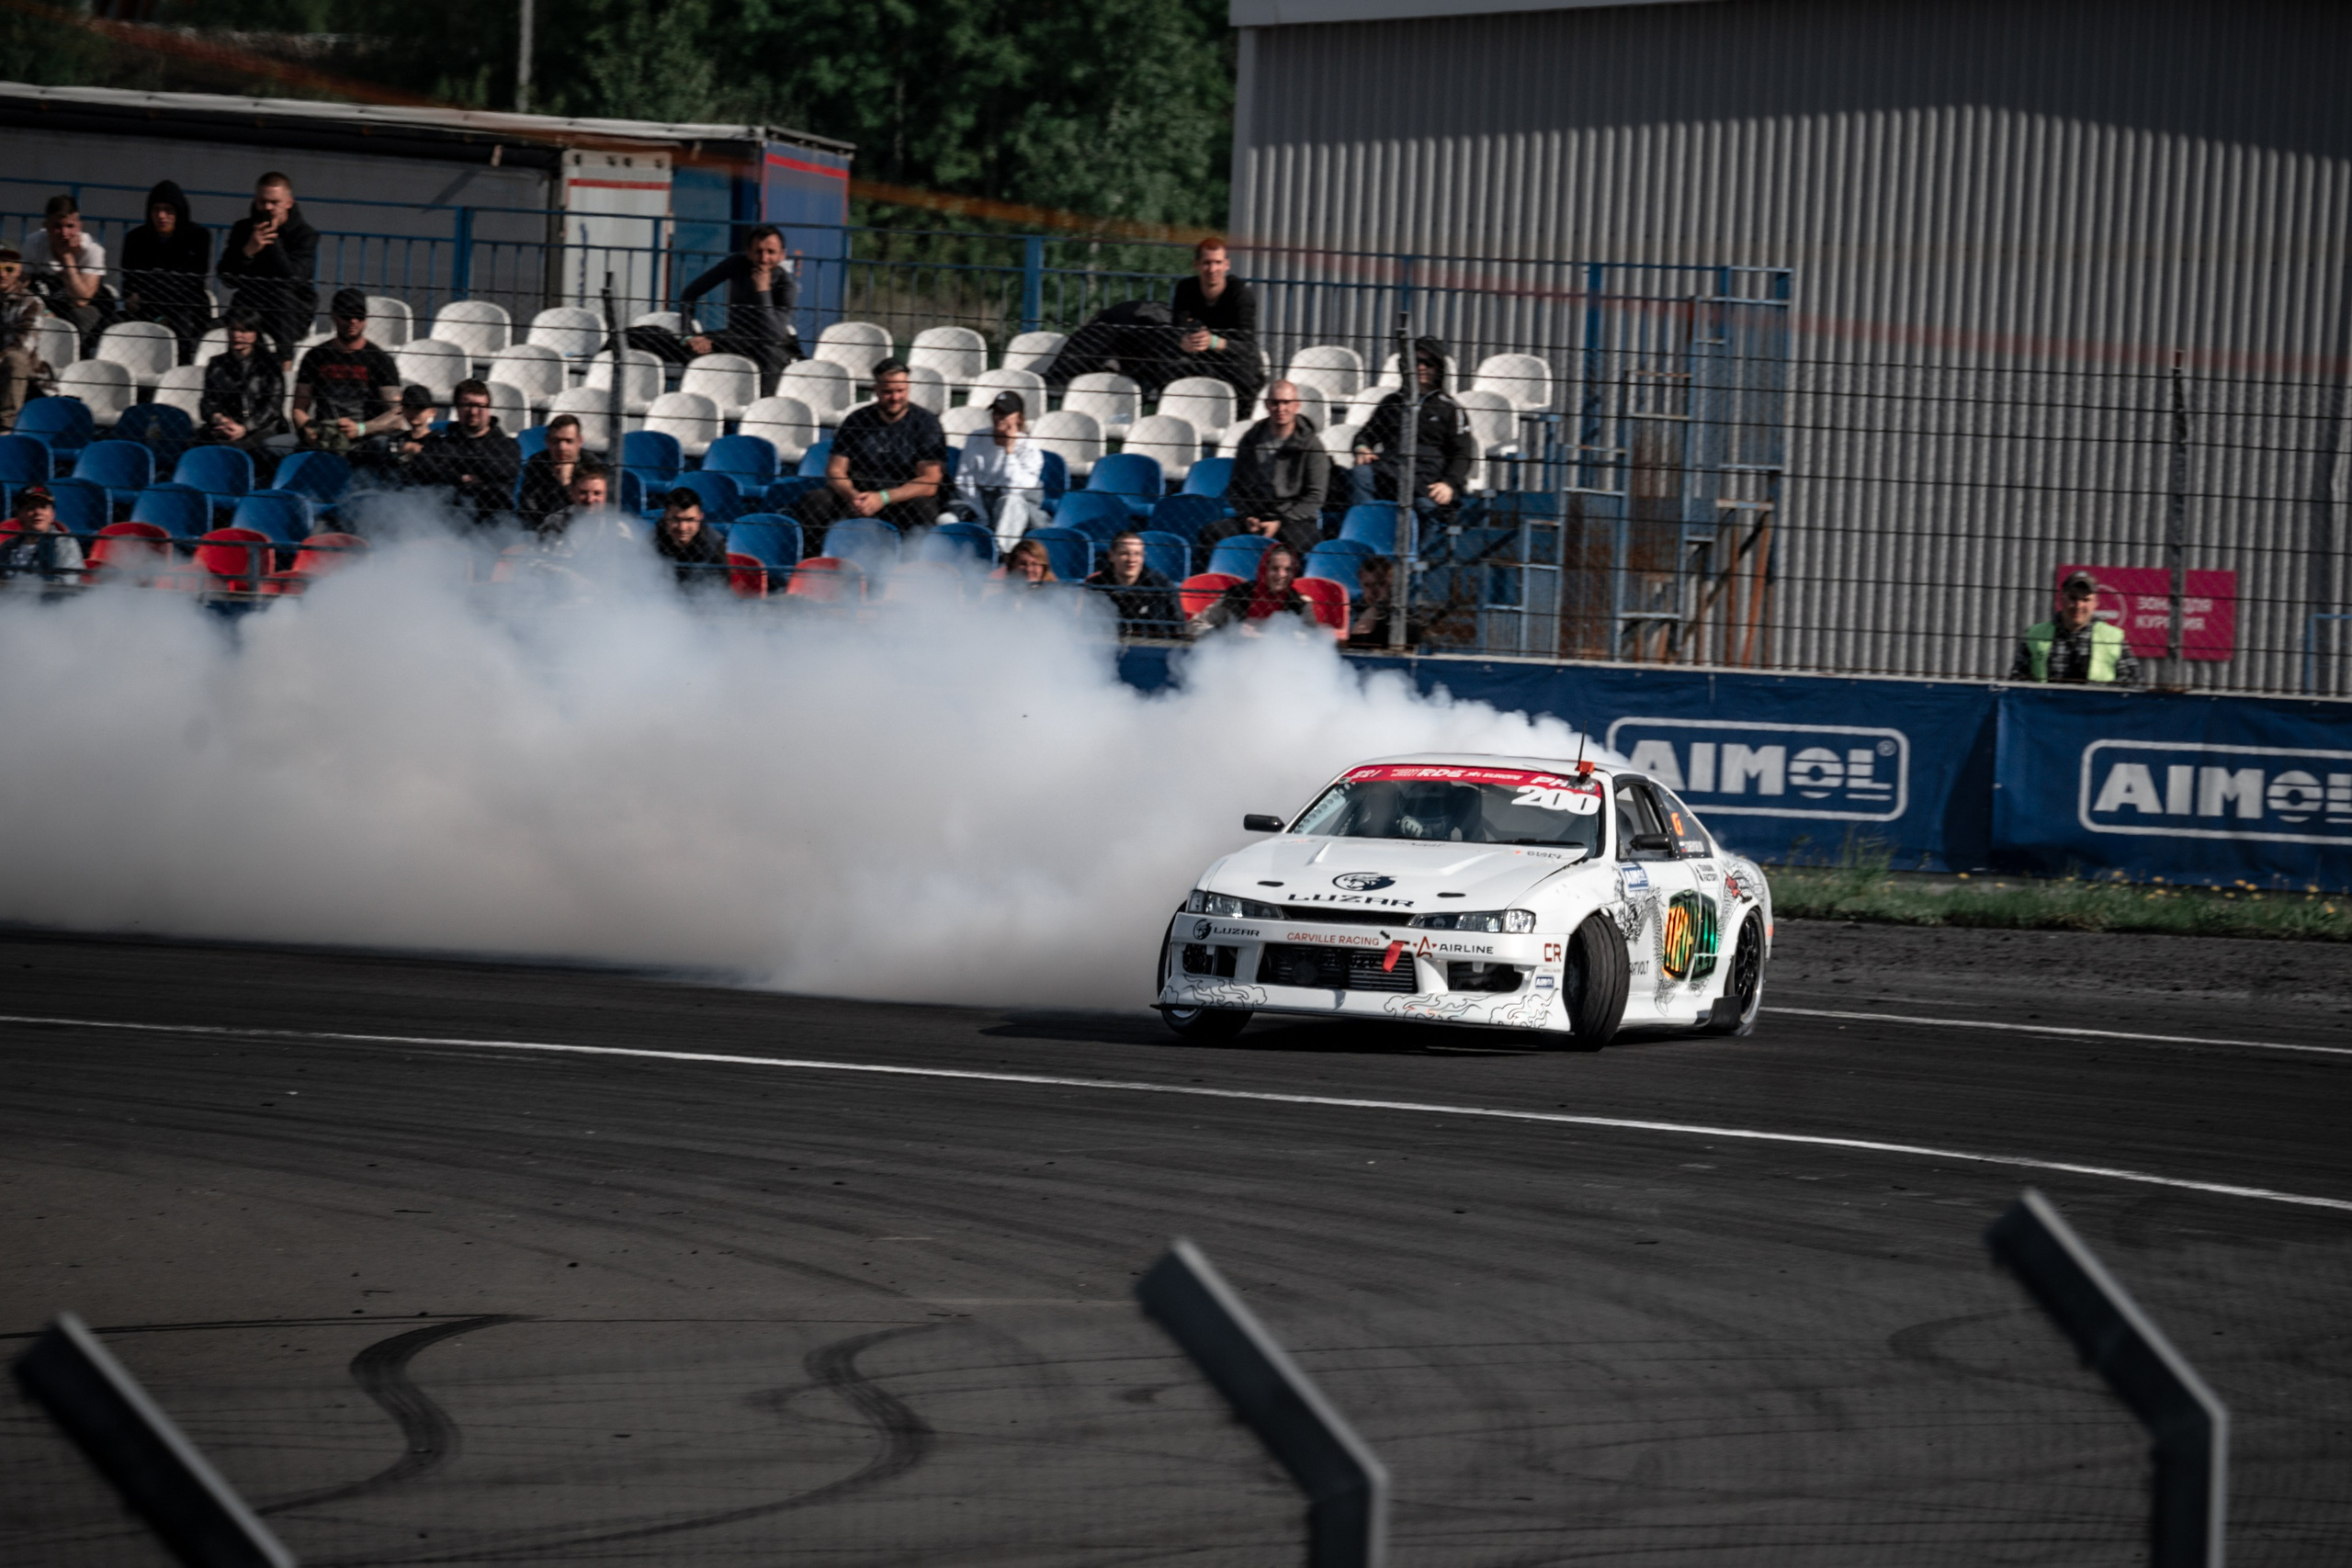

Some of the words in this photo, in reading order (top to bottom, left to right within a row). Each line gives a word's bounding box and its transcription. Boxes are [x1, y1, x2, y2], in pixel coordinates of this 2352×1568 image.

[2137, 597, 2170, 610] ЗОН
[1630, 739, 1894, 801] AIMOL
[1511, 785, 1601, 816] 200
[1288, 894, 1415, 908] LUZAR
[1214, 927, 1261, 937] LUZAR
[1286, 932, 1336, 943] CARVILLE
[1339, 935, 1379, 946] RACING
[1439, 943, 1494, 954] AIRLINE
[1544, 942, 1562, 962] CR
